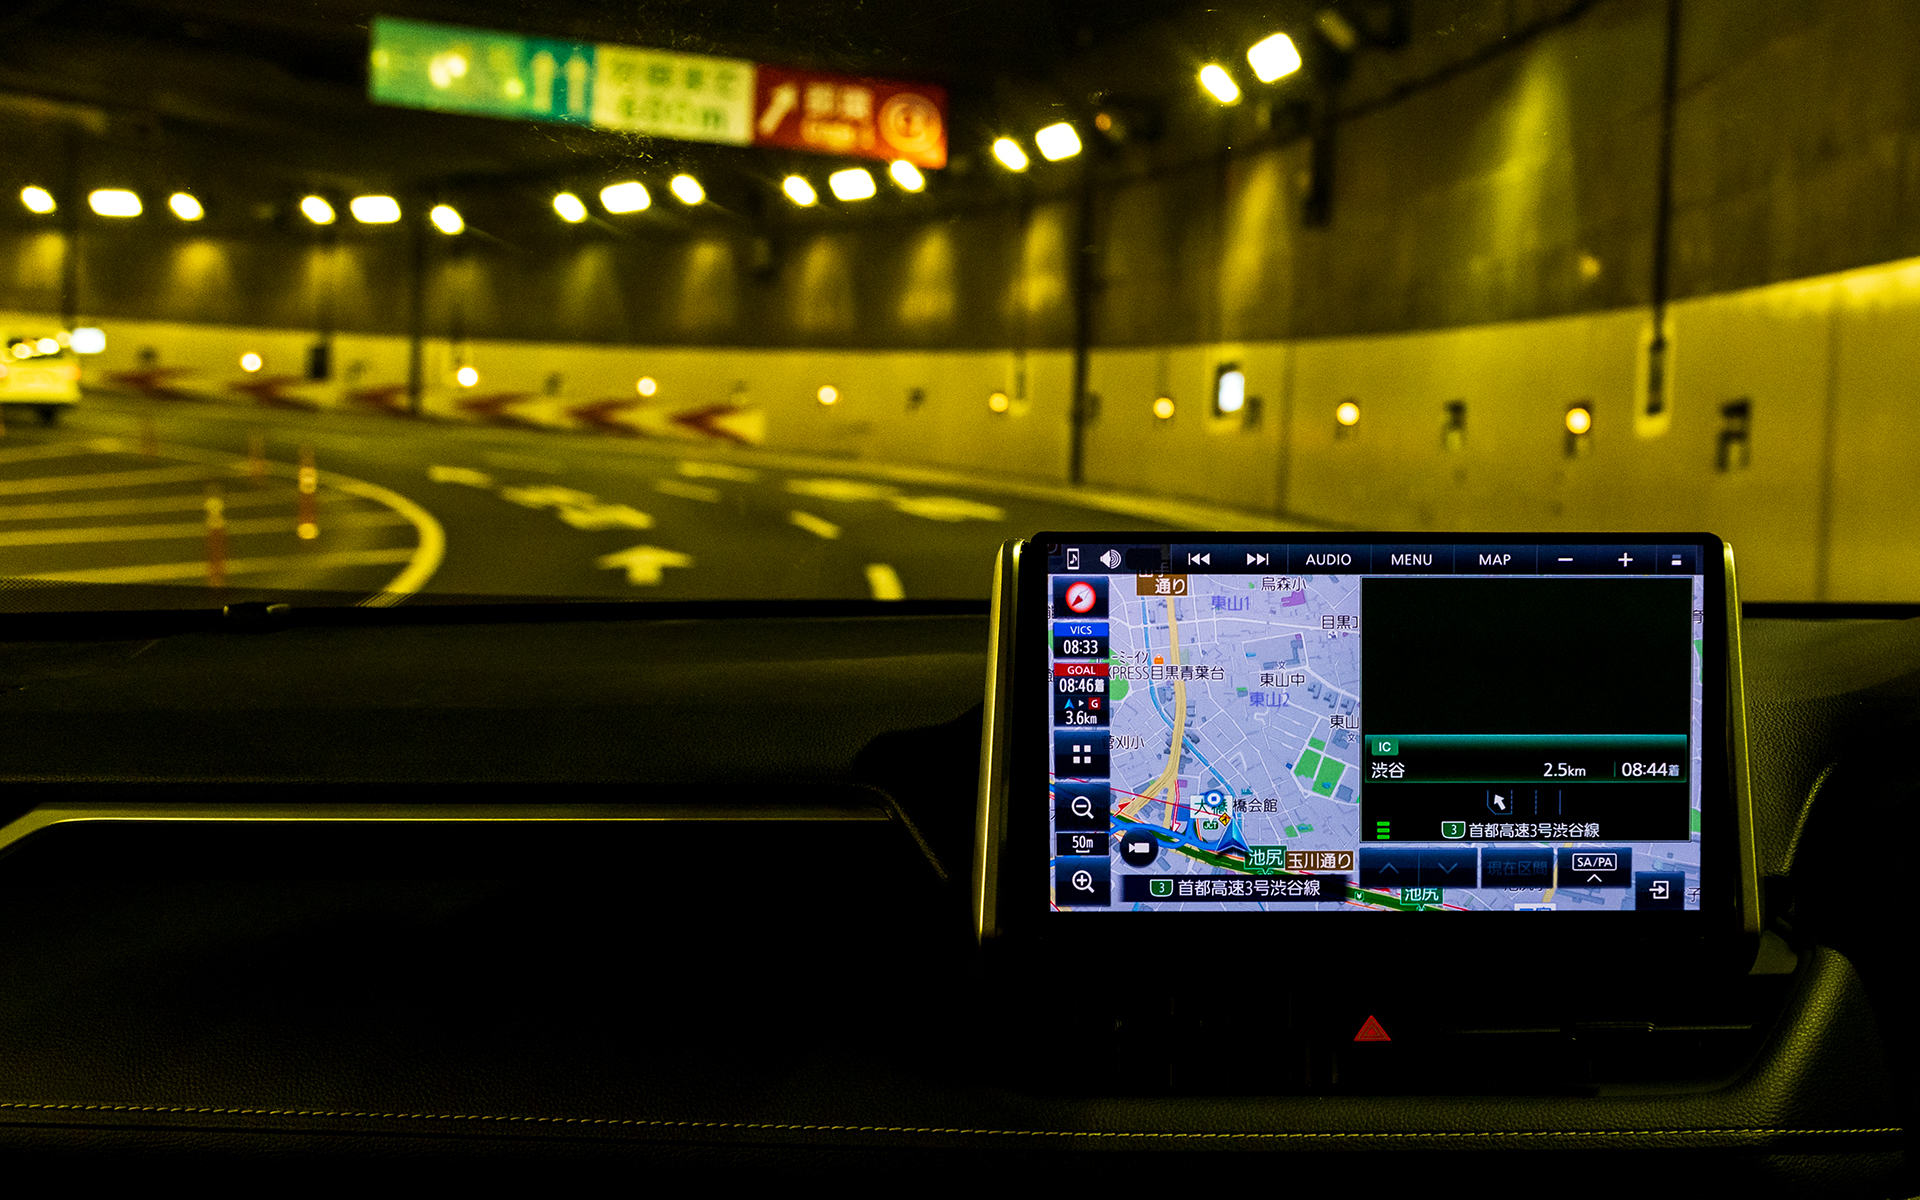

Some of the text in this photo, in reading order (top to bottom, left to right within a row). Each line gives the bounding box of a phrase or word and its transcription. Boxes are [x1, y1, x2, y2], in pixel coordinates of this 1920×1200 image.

[1306, 554, 1351, 565] AUDIO
[1391, 554, 1432, 566] MENU
[1479, 554, 1511, 566] MAP
[1211, 595, 1250, 611] 東山1
[1070, 626, 1092, 635] VICS
[1063, 640, 1098, 654] 08:33
[1067, 666, 1096, 675] GOAL
[1260, 673, 1305, 688] 東山中
[1091, 700, 1098, 708] G
[1250, 692, 1290, 707] 東山2
[1066, 711, 1098, 725] 3.6km
[1379, 741, 1391, 753] IC
[1371, 762, 1405, 779] 渋谷
[1543, 762, 1586, 777] 2.5km
[1451, 823, 1600, 838] 3 首都高速3号渋谷線
[1072, 835, 1093, 848] 50m
[1249, 849, 1283, 866] 池尻
[1288, 853, 1351, 869] 玉川通り
[1577, 857, 1613, 868] SA/PA
[1487, 860, 1548, 876] 現在区間
[1158, 880, 1321, 897] 3 首都高速3号渋谷線
